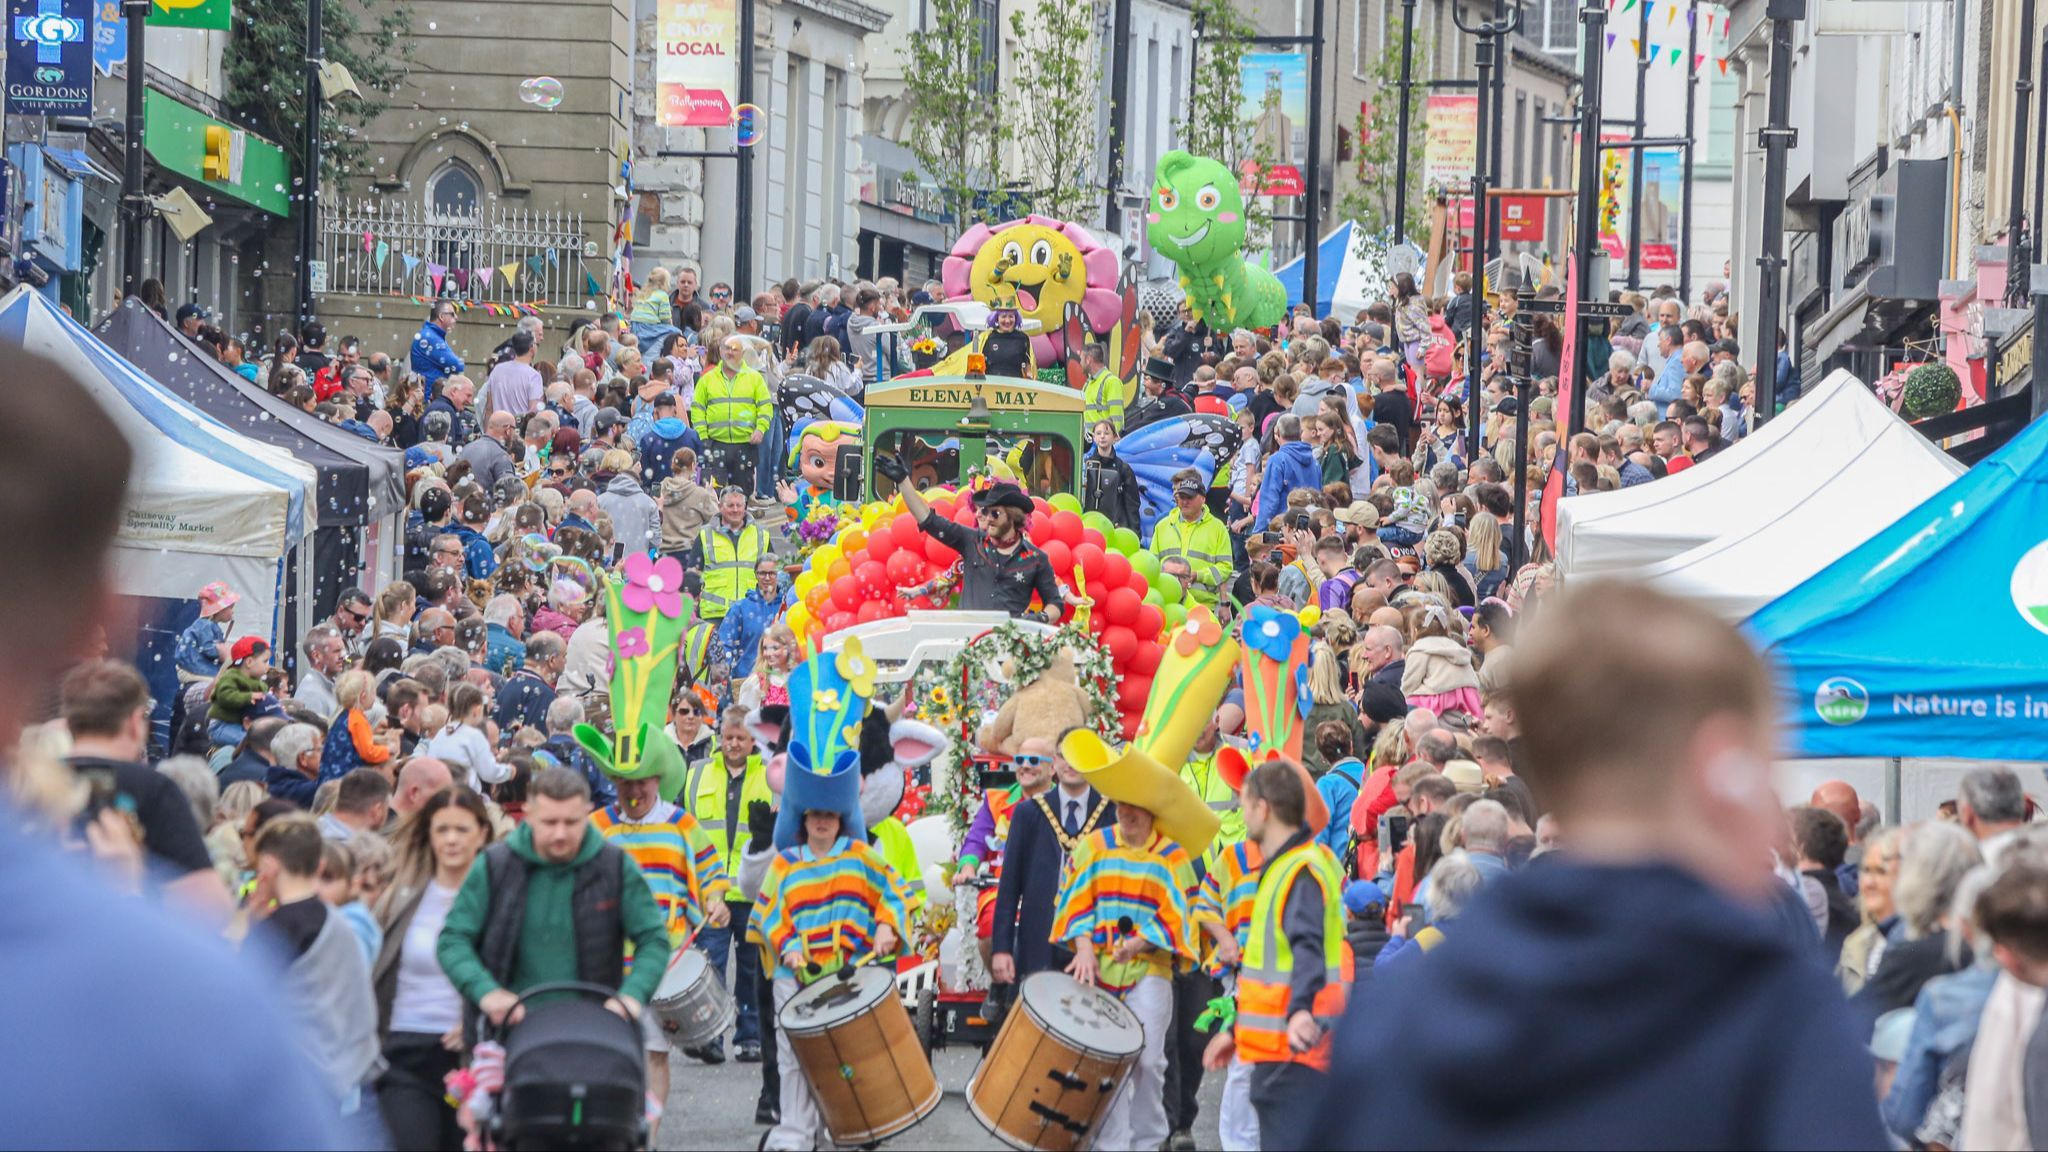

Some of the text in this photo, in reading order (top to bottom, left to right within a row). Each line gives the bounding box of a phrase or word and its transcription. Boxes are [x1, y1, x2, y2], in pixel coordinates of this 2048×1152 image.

[674, 4, 707, 17] EAT
[666, 22, 724, 37] ENJOY
[666, 42, 725, 55] LOCAL
[10, 84, 88, 98] GORDONS
[669, 95, 724, 112] Ballymoney
[896, 179, 924, 210] Danske
[1590, 305, 1620, 313] PARK
[909, 389, 1039, 405] ELENA MAY
[127, 510, 177, 522] Causeway
[126, 519, 214, 533] Speciality Market
[1892, 693, 1988, 717] Nature
[1995, 694, 2017, 718] is
